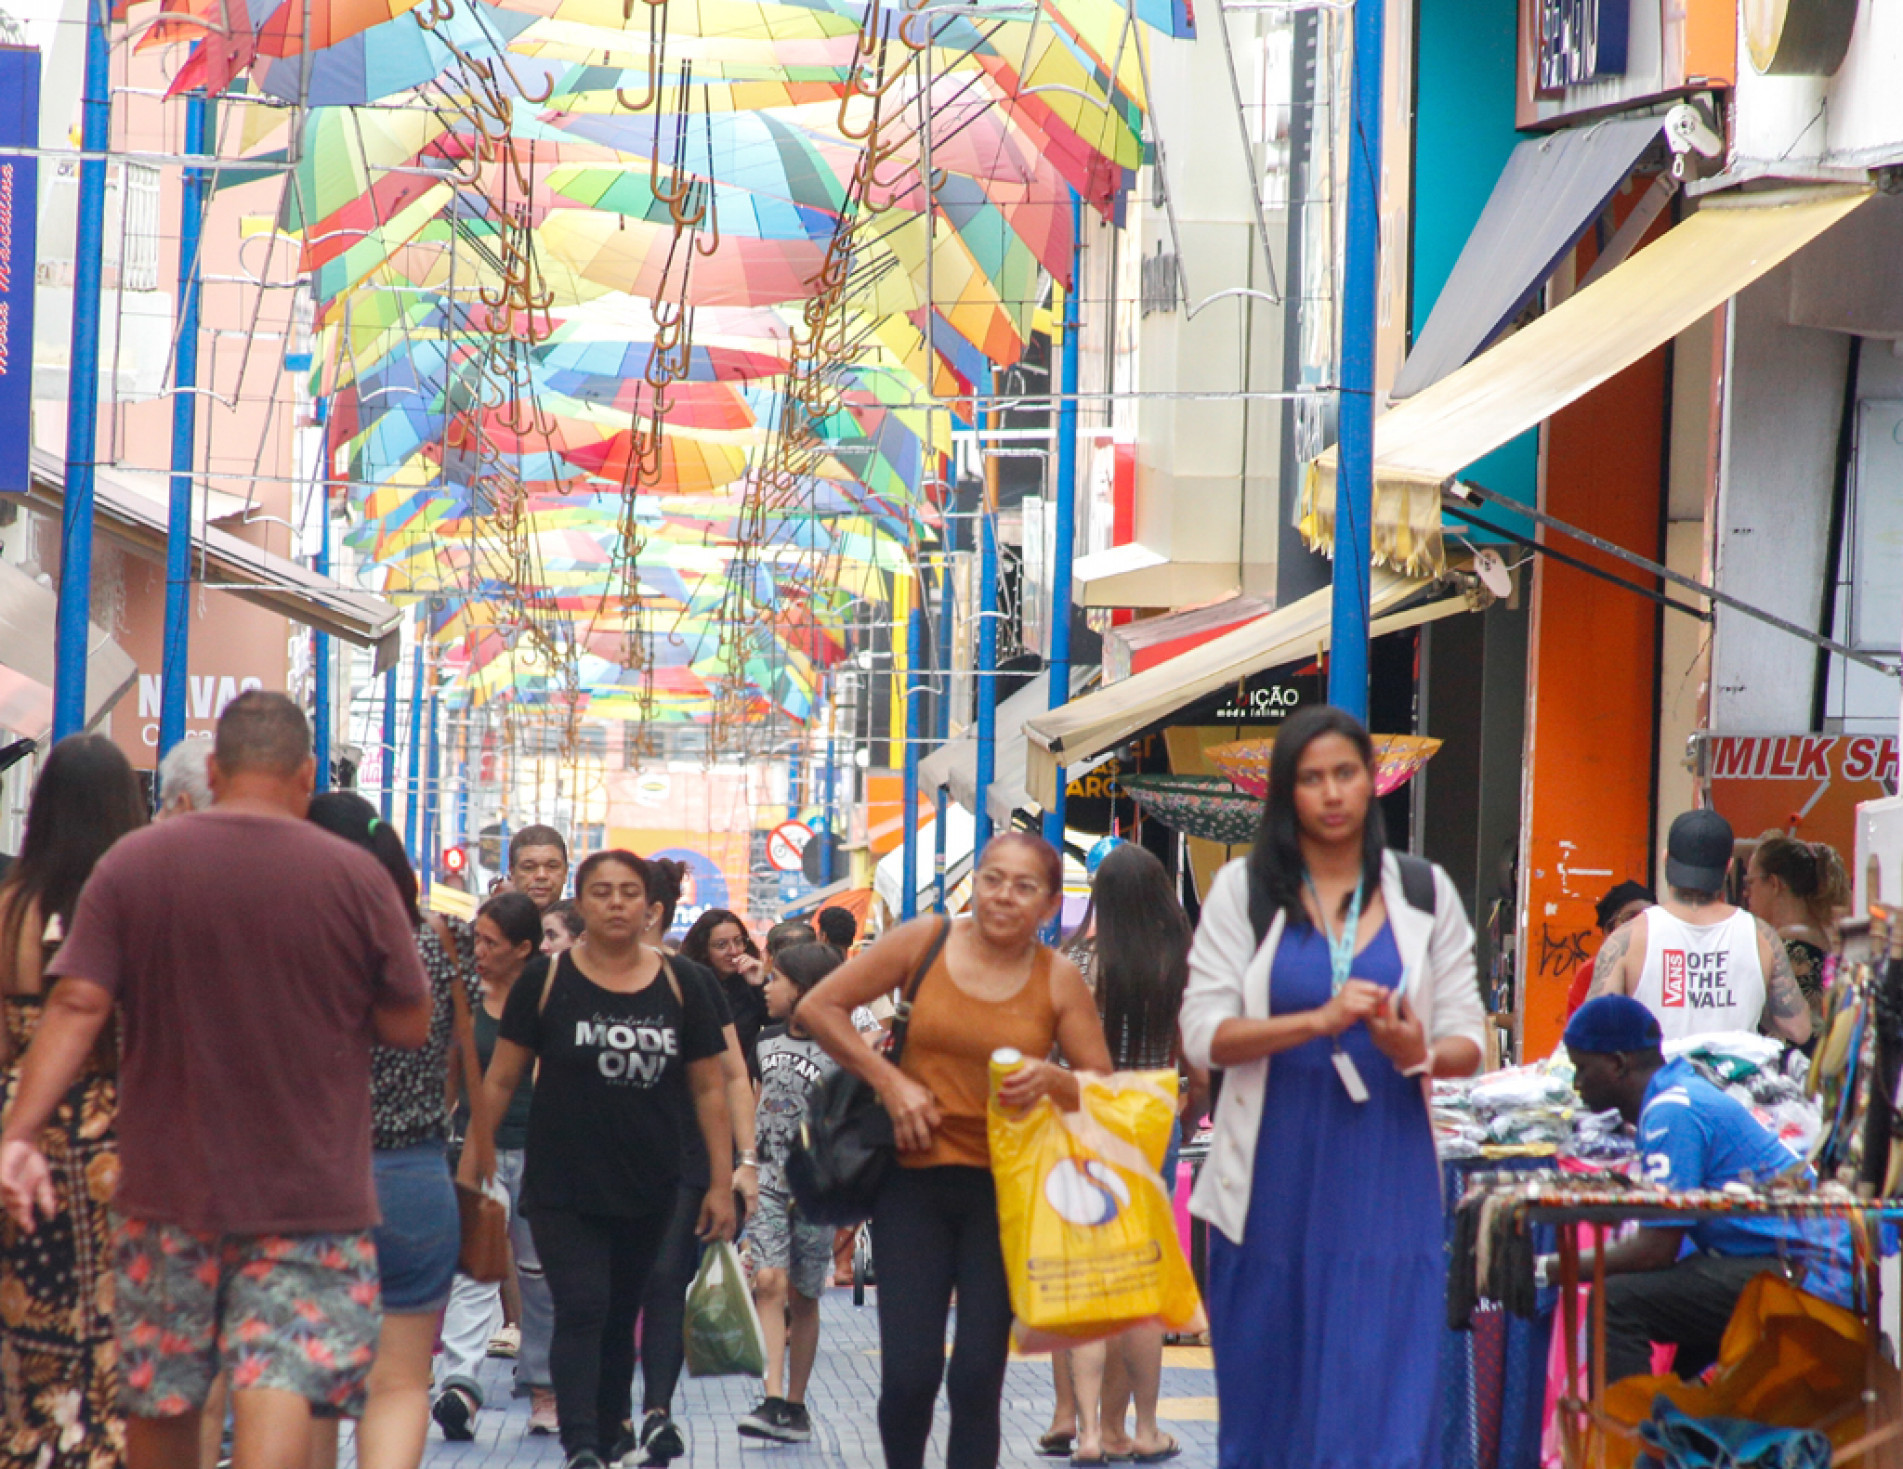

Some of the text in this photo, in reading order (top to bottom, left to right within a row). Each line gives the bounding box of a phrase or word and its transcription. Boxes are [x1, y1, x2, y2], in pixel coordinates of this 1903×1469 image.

[1712, 736, 1839, 780] MILK
[1687, 951, 1729, 970] OFF
[1664, 952, 1683, 1005] VANS
[1687, 971, 1727, 989] THE
[1687, 990, 1737, 1009] WALL
[575, 1020, 678, 1056] MODE
[598, 1051, 667, 1083] ON!
